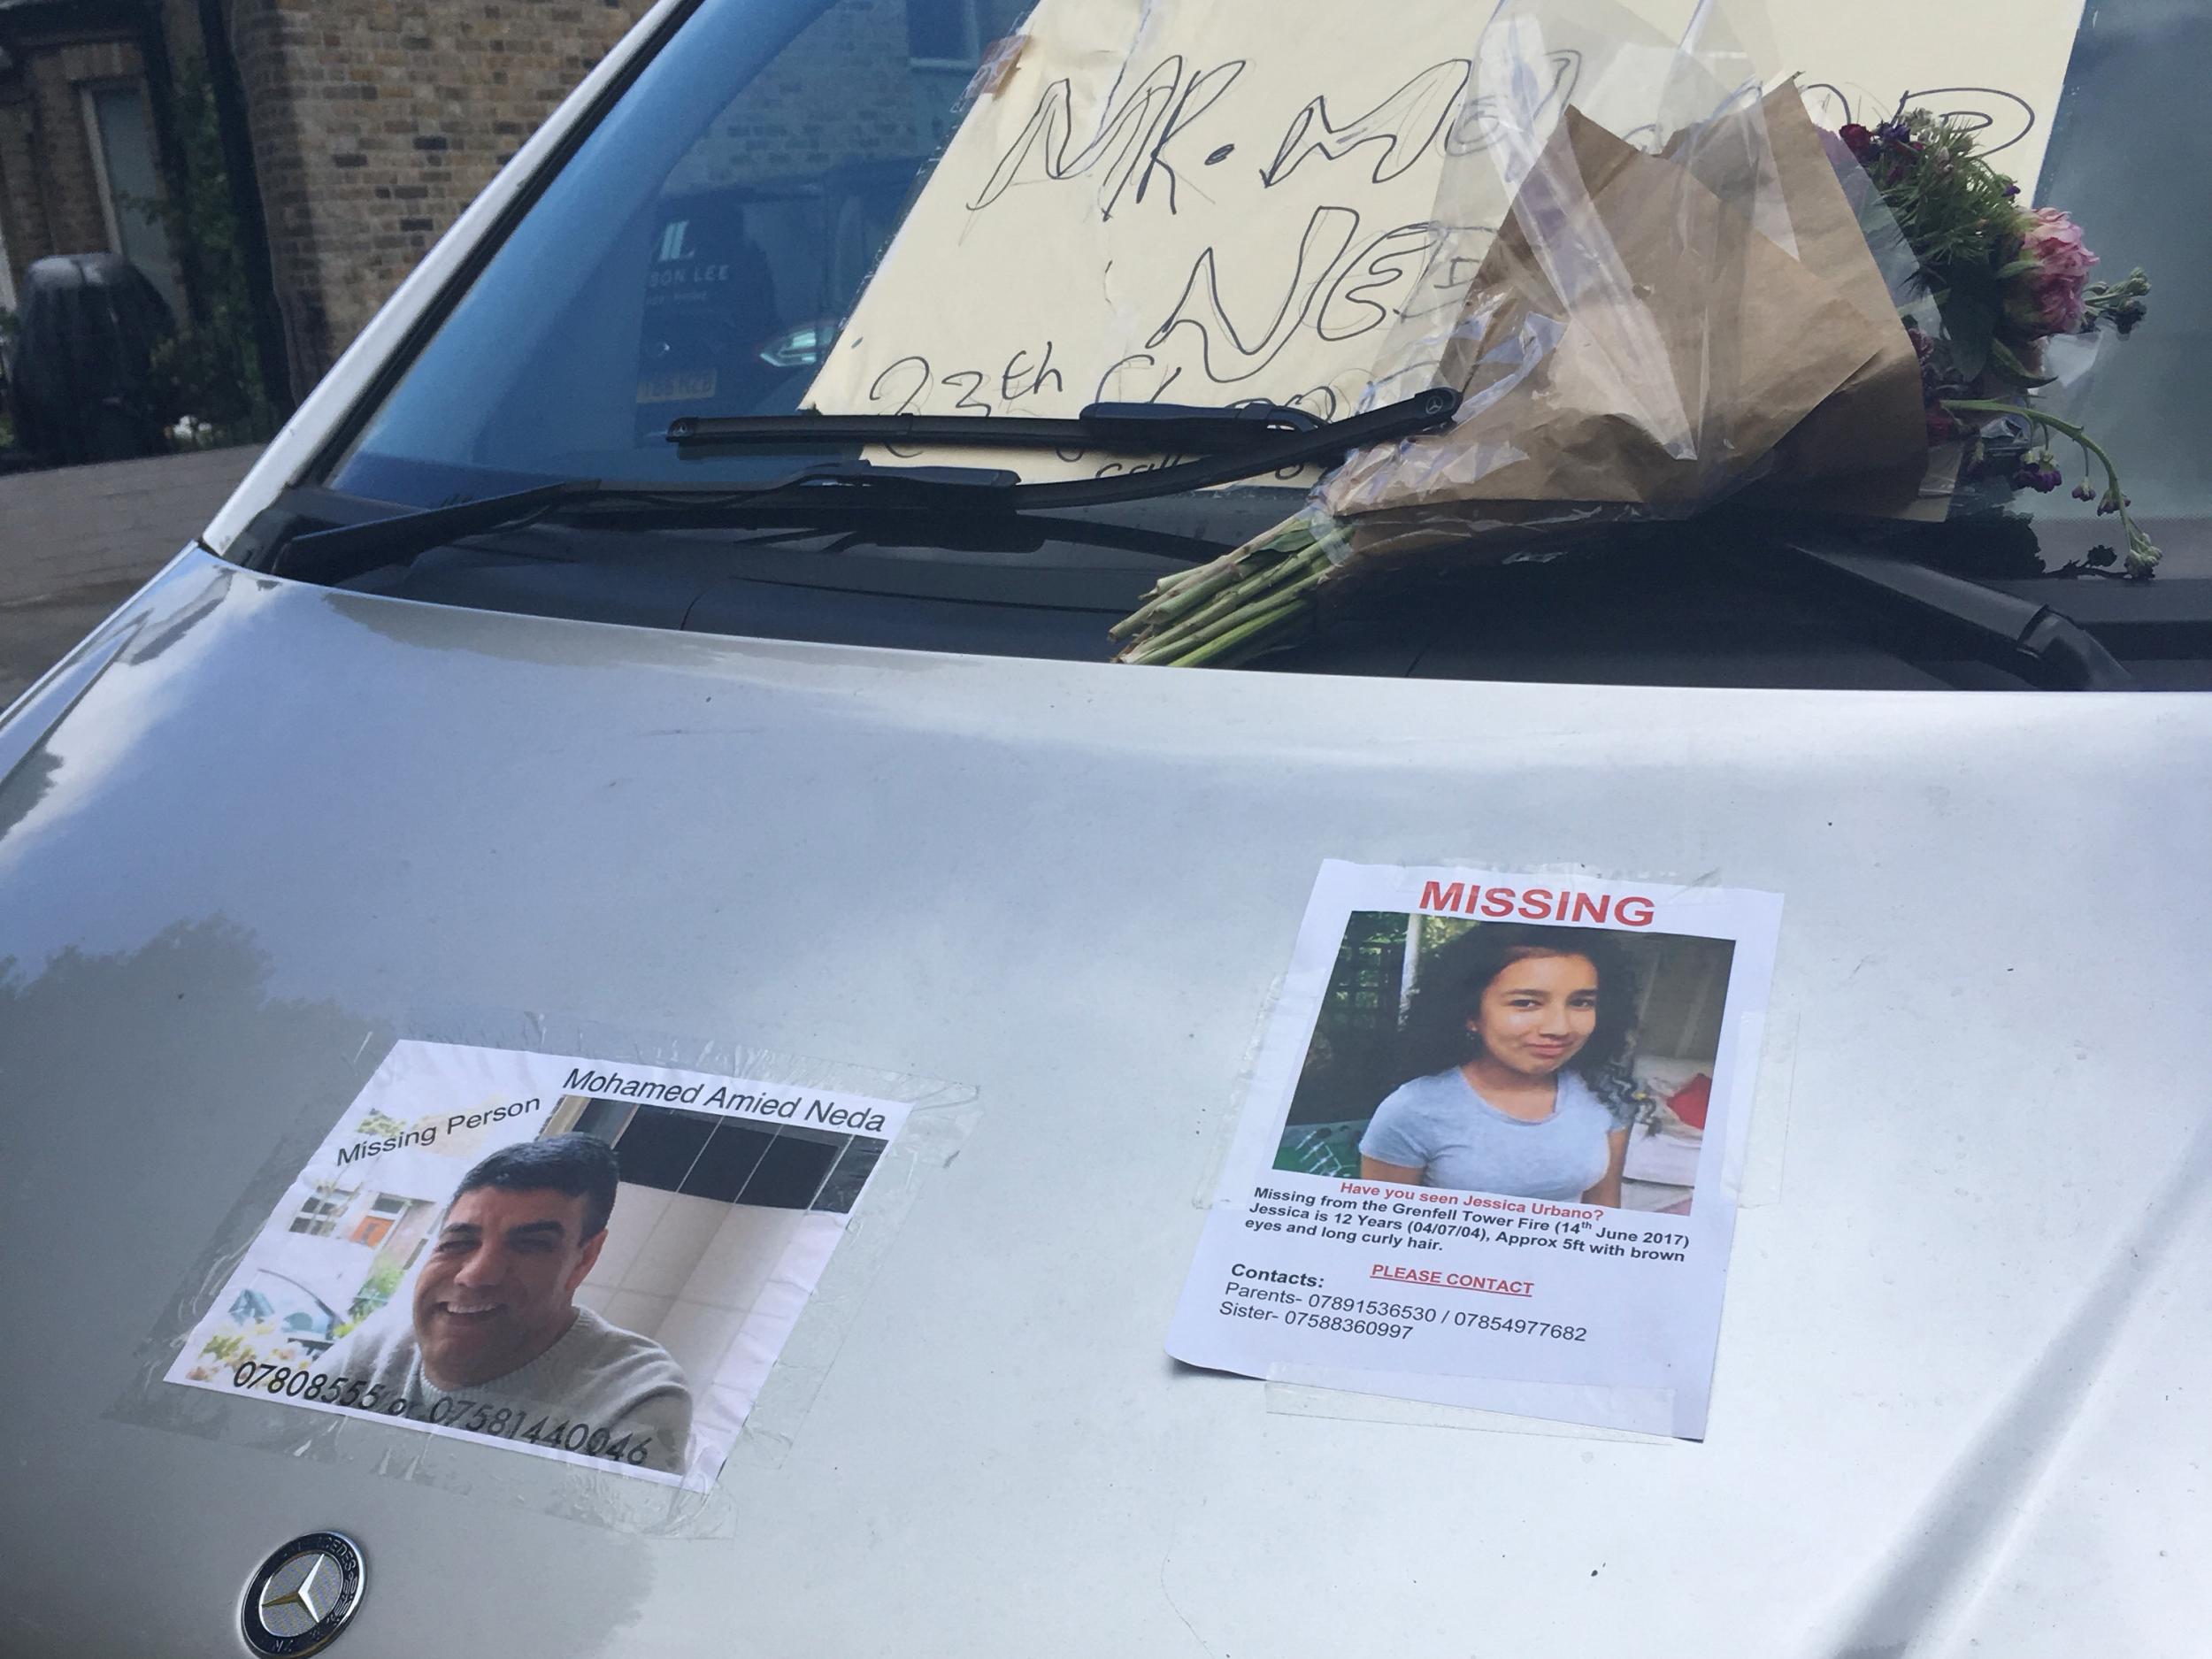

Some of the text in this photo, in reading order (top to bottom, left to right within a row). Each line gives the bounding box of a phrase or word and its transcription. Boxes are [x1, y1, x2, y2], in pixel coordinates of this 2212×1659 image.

[693, 265, 730, 282] LEE
[1418, 880, 1655, 927] MISSING
[562, 1067, 887, 1133] Mohamed Amied Neda
[335, 1094, 541, 1167] Missing Person
[1254, 1187, 1316, 1206] Missing
[1320, 1195, 1357, 1210] from
[1362, 1200, 1387, 1212] the
[1392, 1202, 1457, 1221] Grenfell
[1463, 1210, 1514, 1227] Tower
[1517, 1217, 1550, 1231] Fire
[1595, 1226, 1639, 1242] June
[1642, 1232, 1690, 1248] 2017)
[1340, 1181, 1604, 1222] Have you seen Jessica Urbano?
[1245, 1218, 1443, 1251] eyes and long curly hair.
[1248, 1202, 1686, 1263] Jessica is 12 Years (04/07/04), Approx 5ft with brown
[1231, 1263, 1325, 1288] Contacts:
[1371, 1263, 1535, 1296] PLEASE CONTACT
[1219, 1301, 1414, 1340] Sister- 07588360997
[1225, 1280, 1587, 1342] Parents- 07891536530 / 07854977682
[428, 1395, 654, 1465] 07581440046
